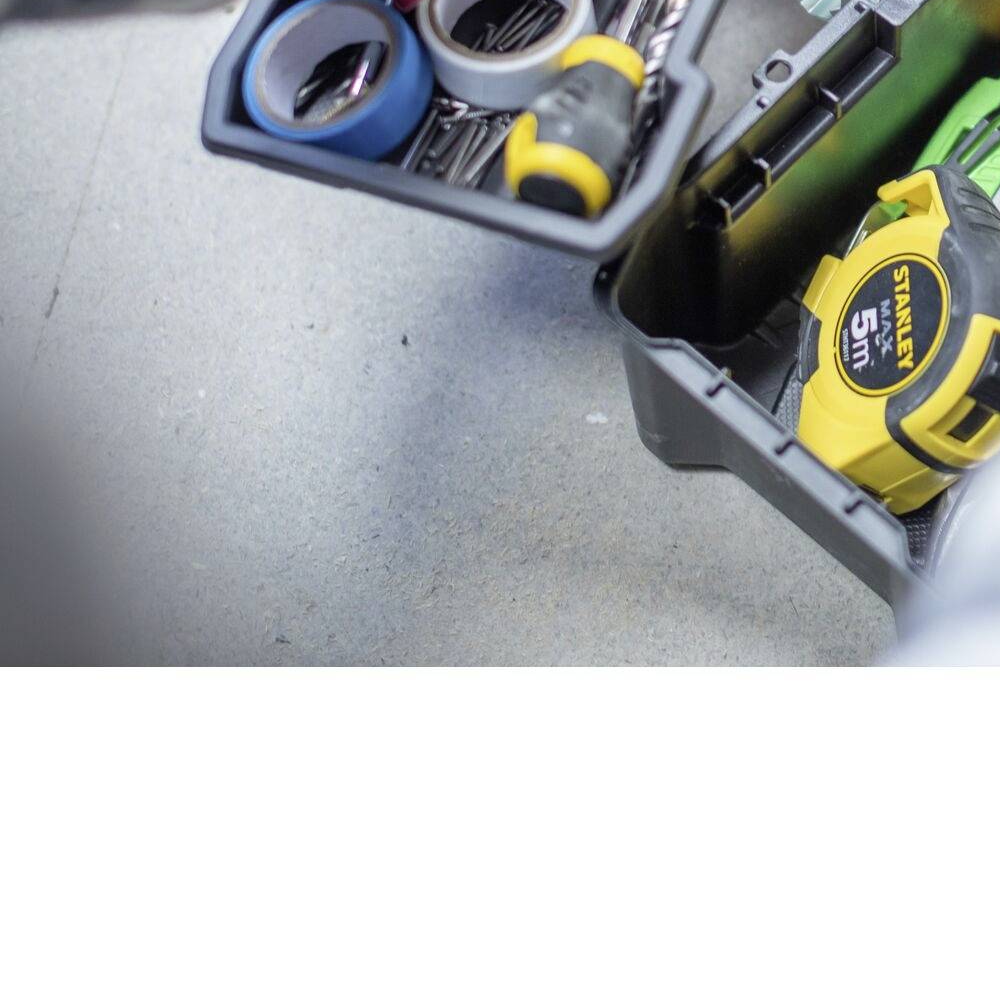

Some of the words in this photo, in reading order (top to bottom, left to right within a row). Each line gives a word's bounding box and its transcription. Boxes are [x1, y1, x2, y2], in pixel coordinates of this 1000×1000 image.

[851, 307, 878, 370] 5m
[879, 298, 894, 353] MAX
[893, 264, 914, 369] STANLEY
